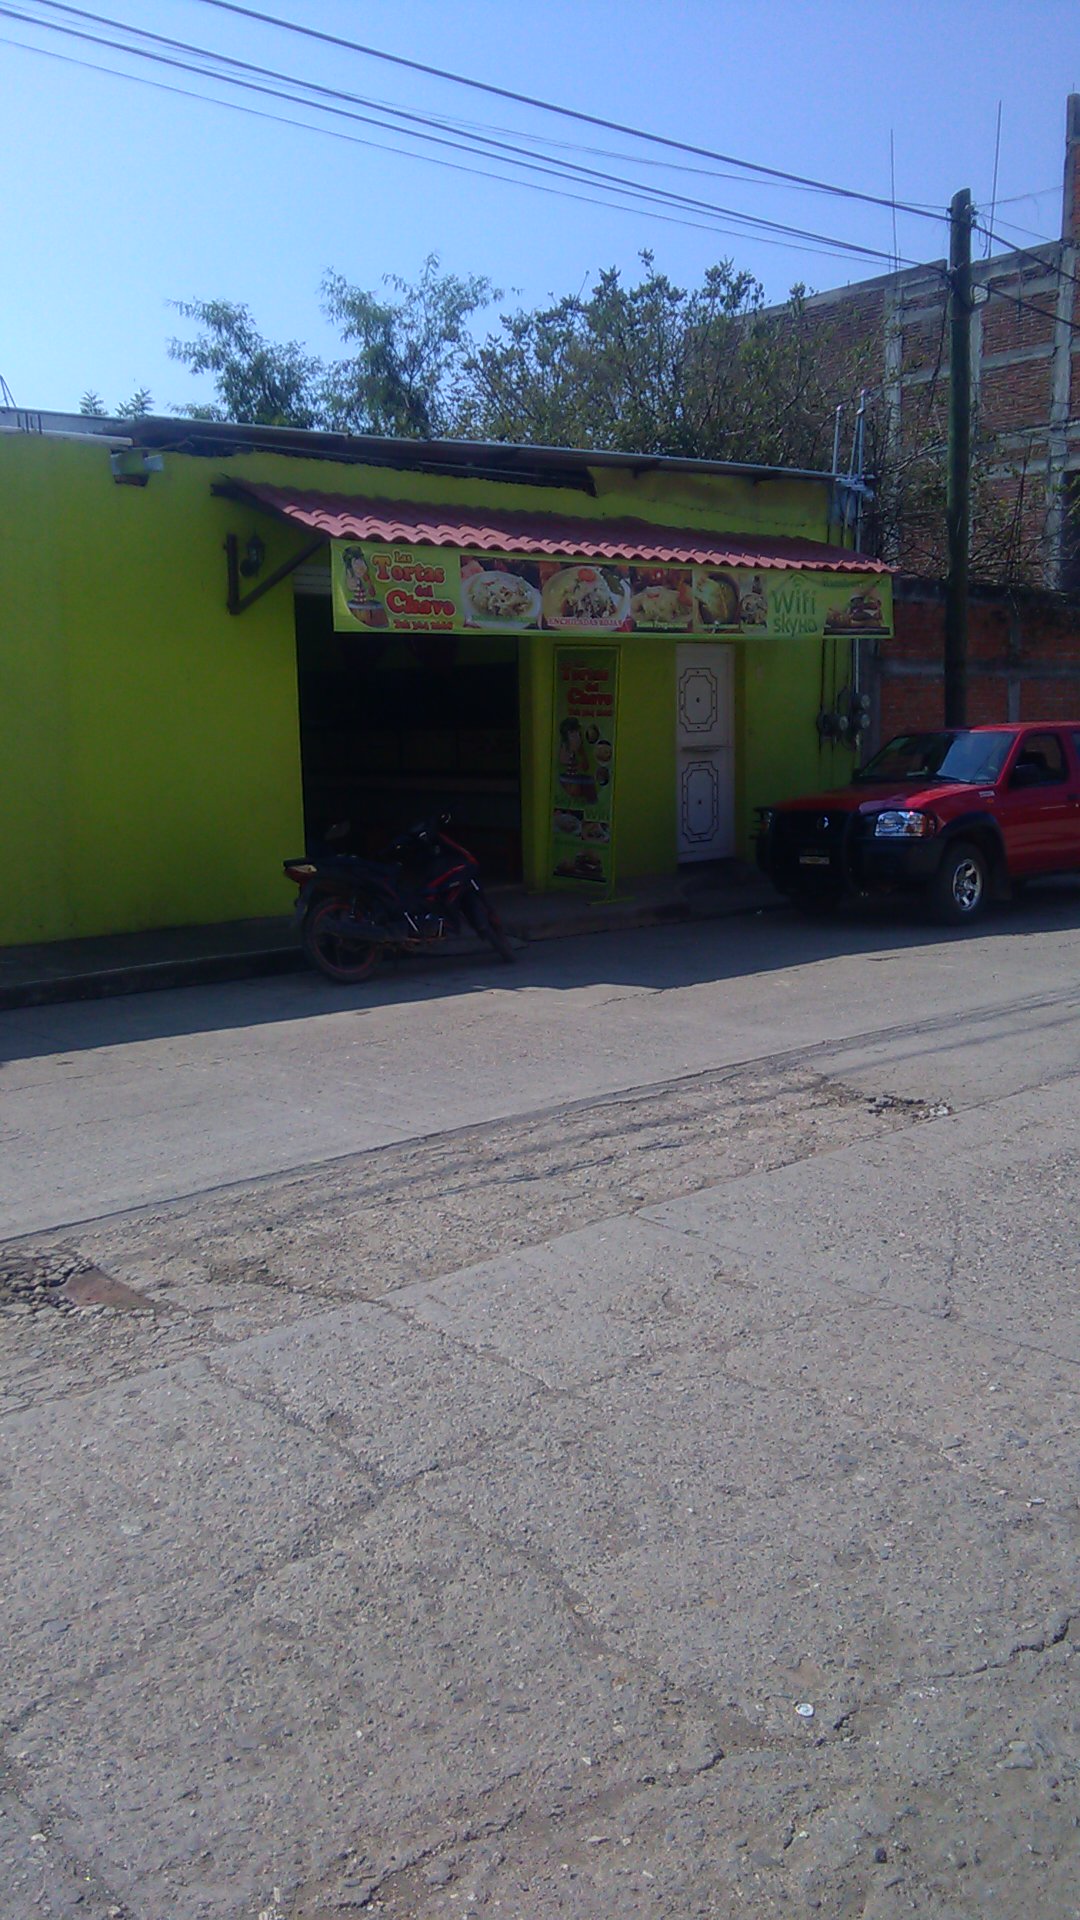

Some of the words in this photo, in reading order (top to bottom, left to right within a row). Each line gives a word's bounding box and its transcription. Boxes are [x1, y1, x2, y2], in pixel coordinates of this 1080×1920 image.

[371, 554, 446, 584] Tortas
[386, 589, 455, 617] Chavo
[415, 584, 434, 598] del
